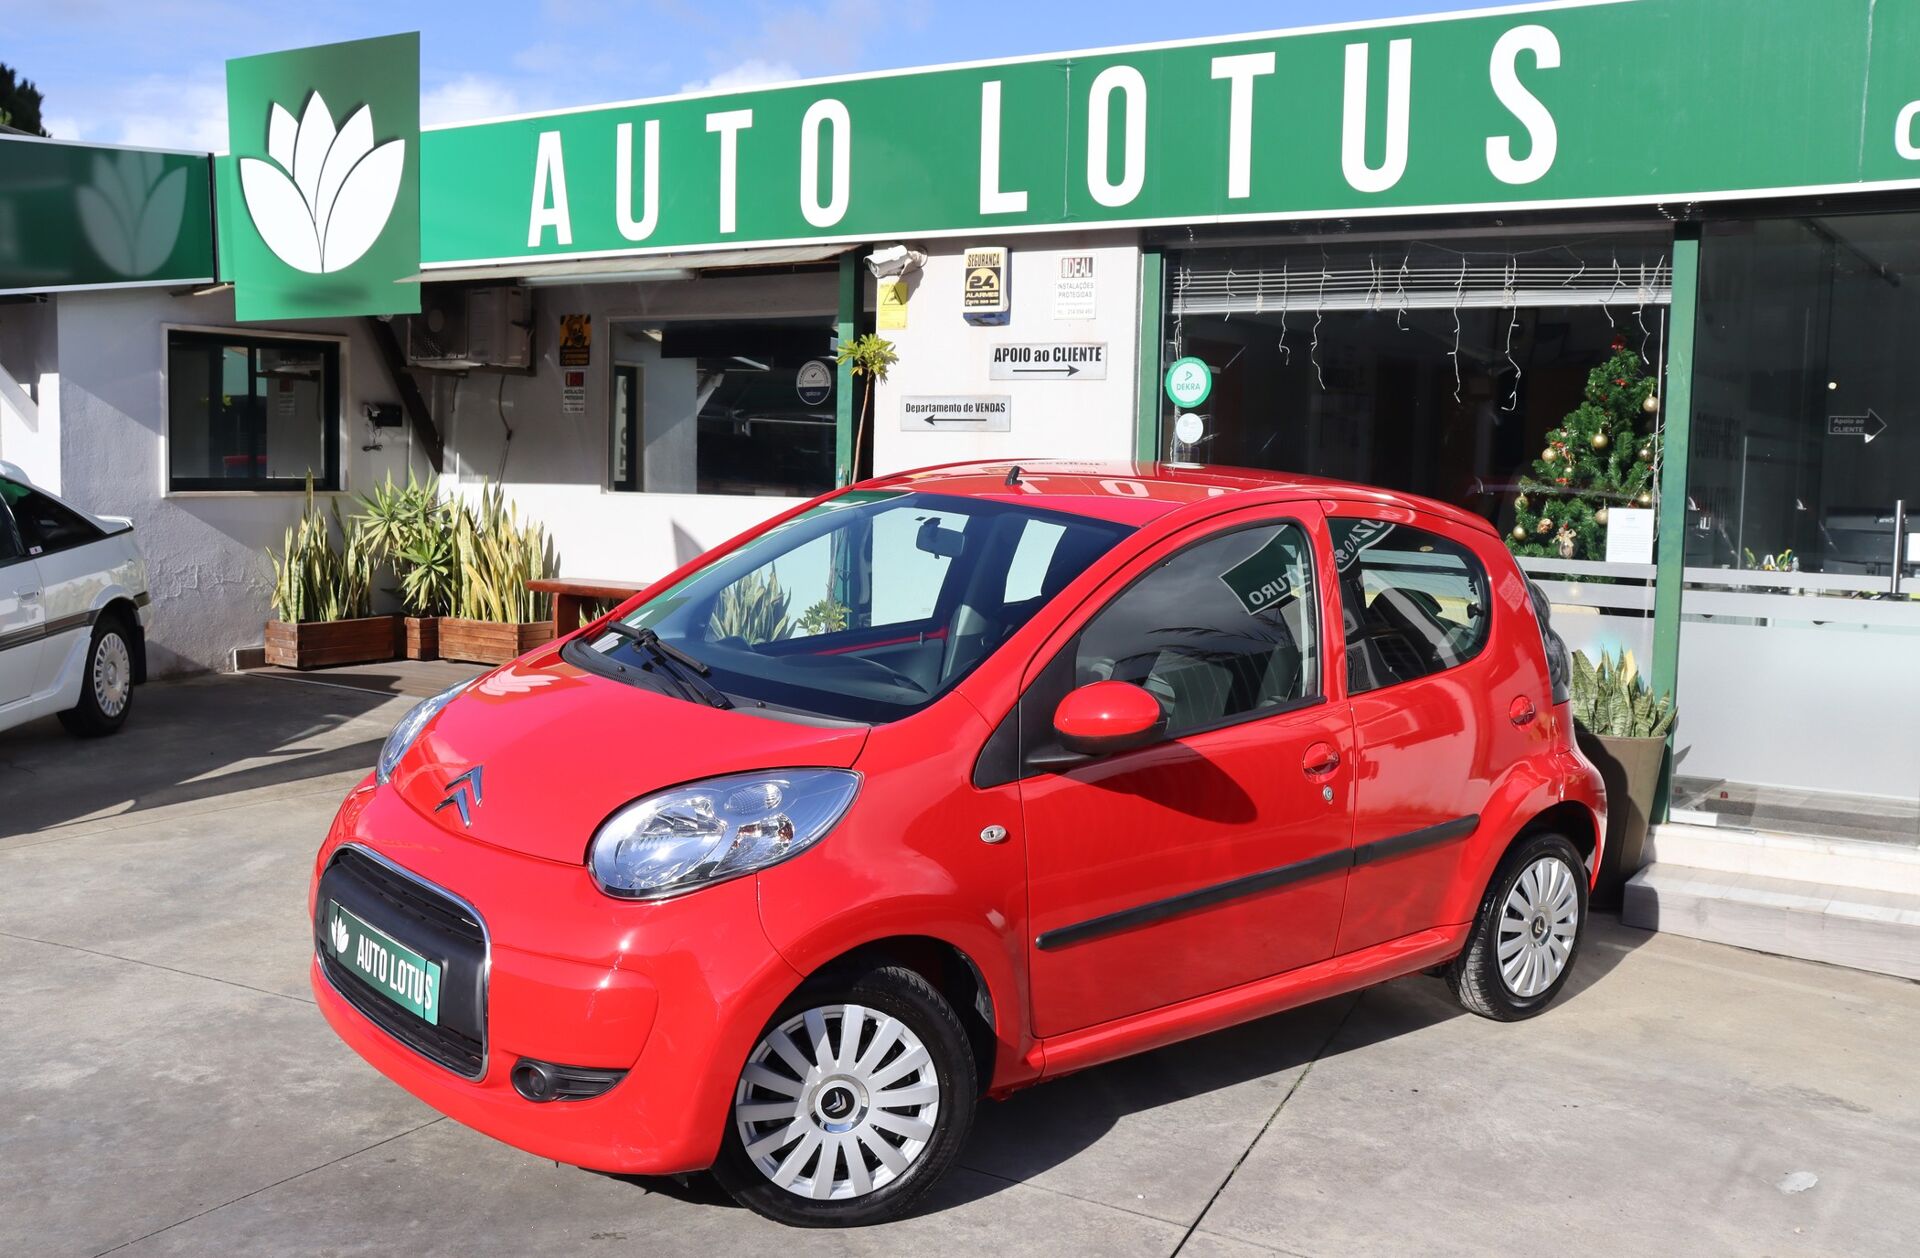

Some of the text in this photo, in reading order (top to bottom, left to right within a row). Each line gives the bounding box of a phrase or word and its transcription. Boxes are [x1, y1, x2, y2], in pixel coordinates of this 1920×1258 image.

[527, 24, 1561, 248] AUTO LOTUS
[969, 275, 995, 289] 24
[994, 346, 1102, 362] APOIO ao CLIENTE
[1176, 383, 1200, 391] DEKRA
[905, 403, 1005, 413] Departamento de VENDAS
[357, 933, 433, 1010] AUTO LOTUS
